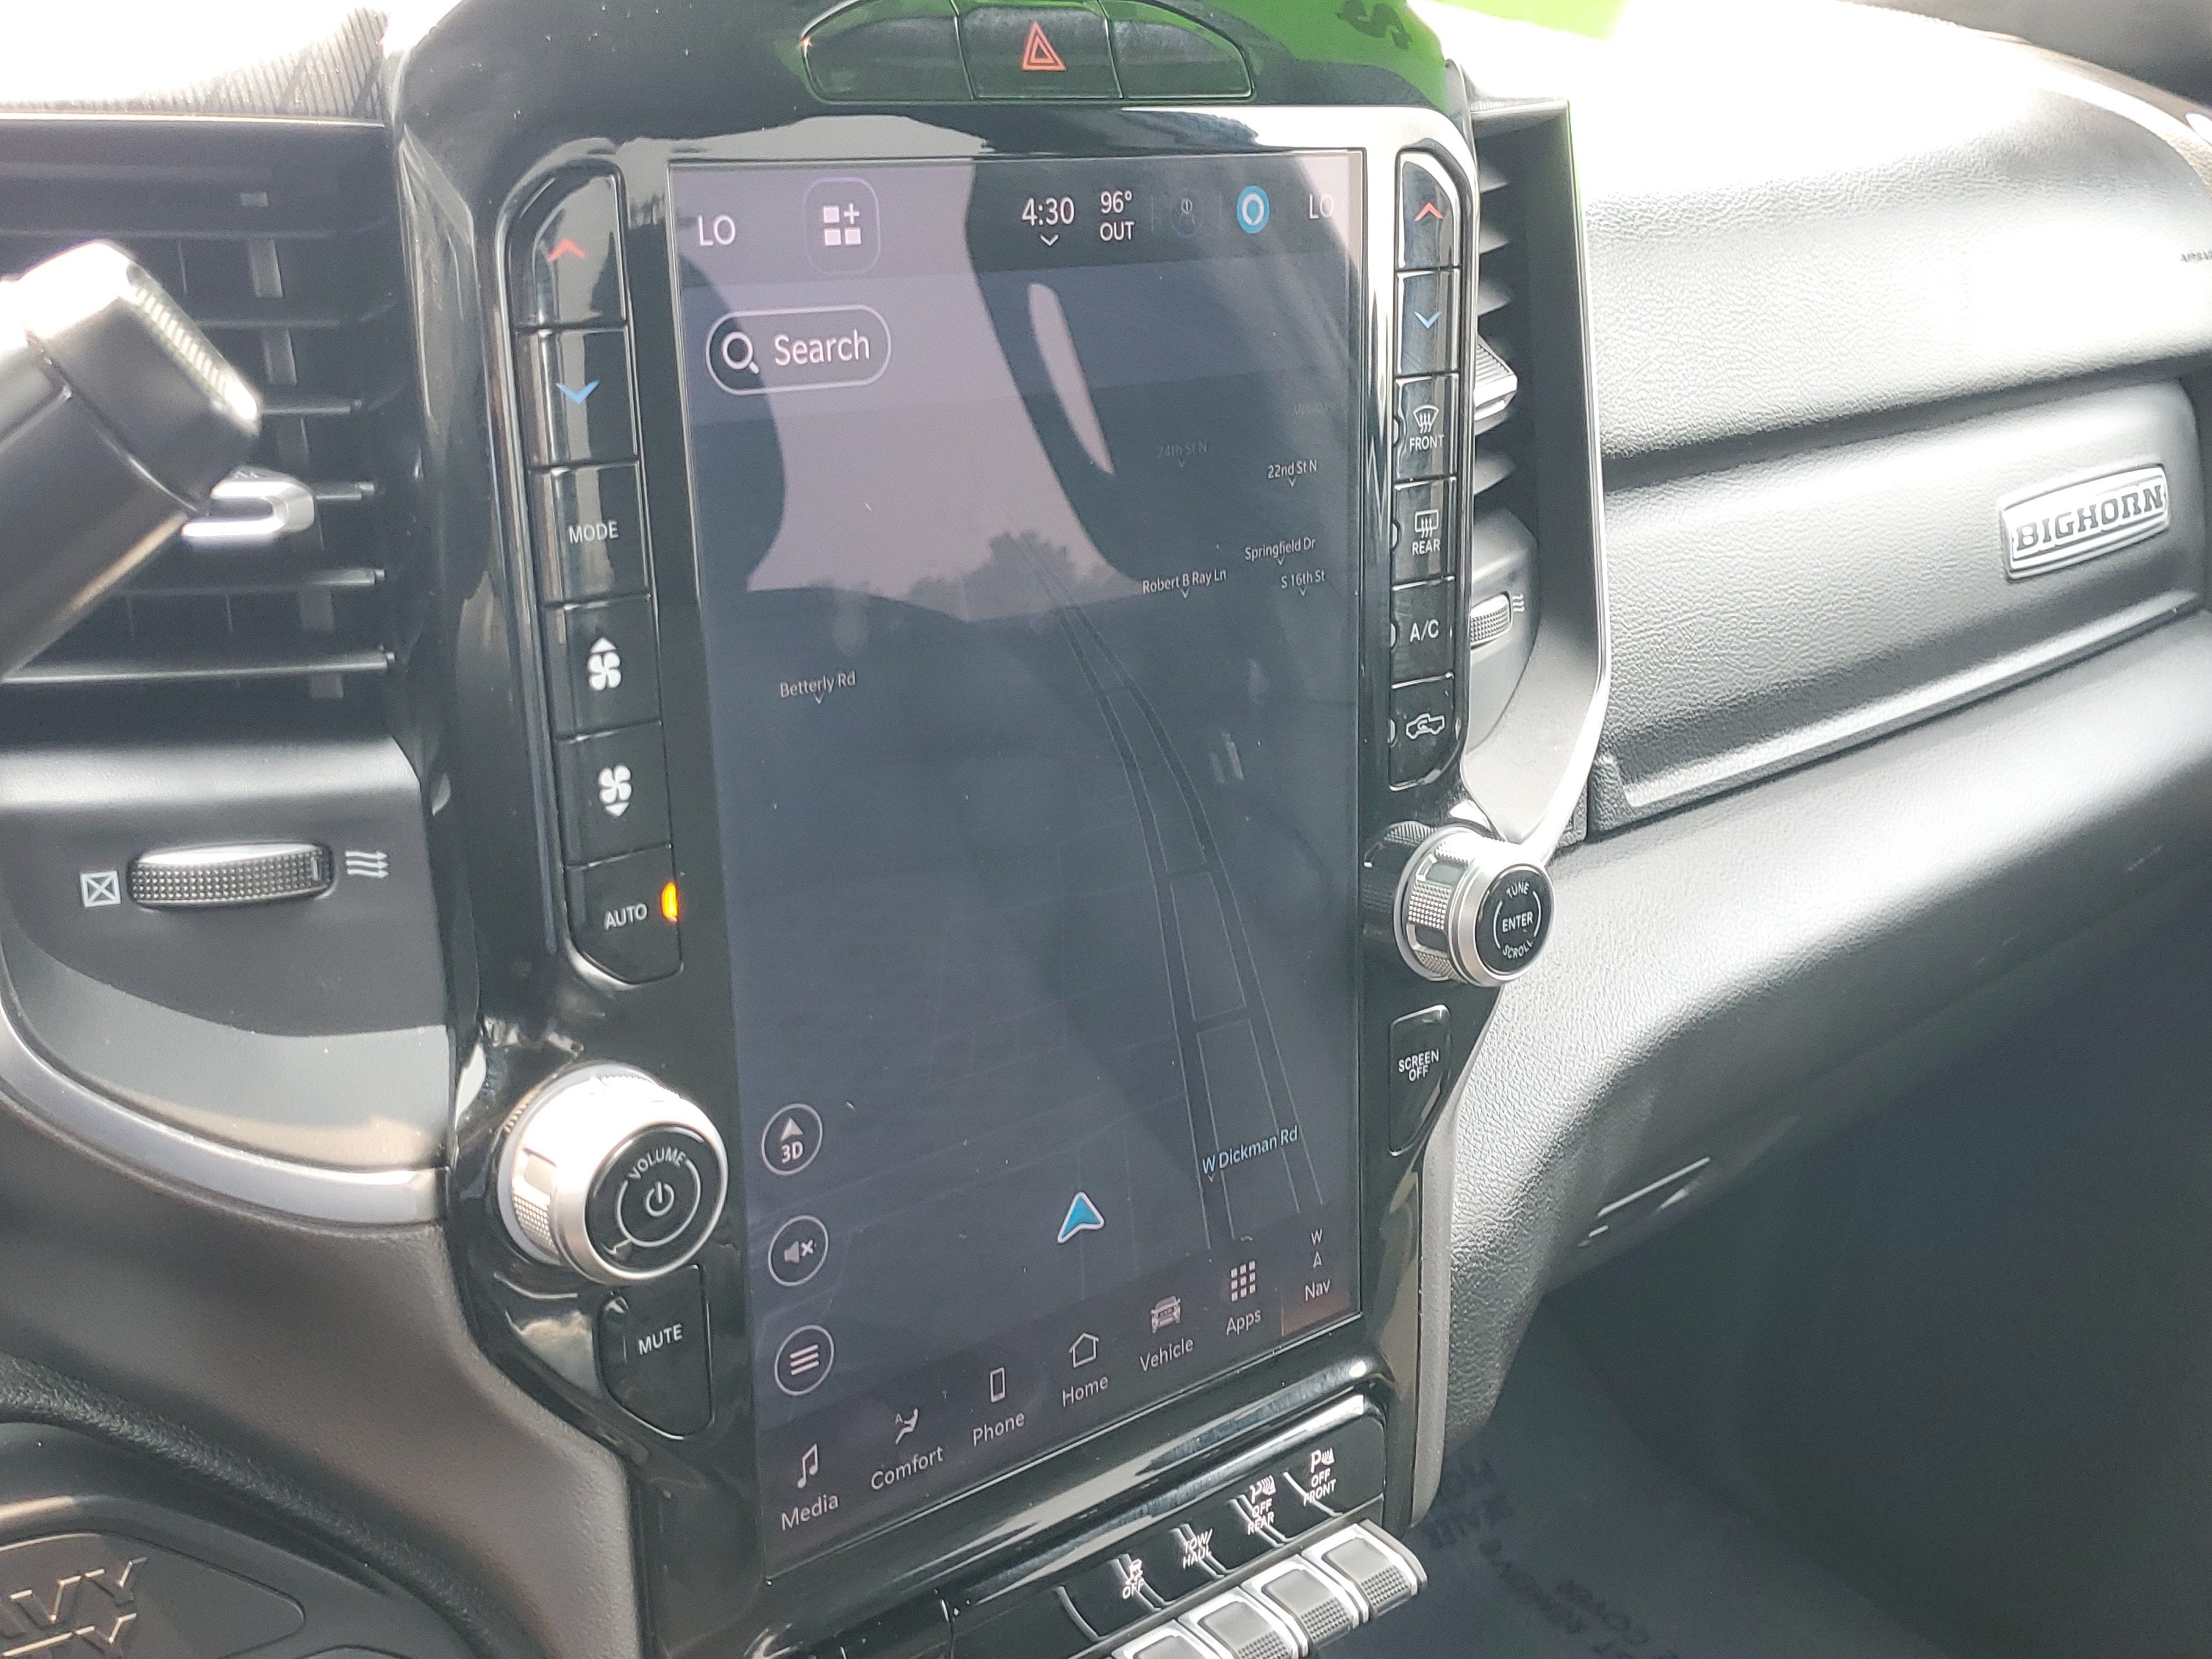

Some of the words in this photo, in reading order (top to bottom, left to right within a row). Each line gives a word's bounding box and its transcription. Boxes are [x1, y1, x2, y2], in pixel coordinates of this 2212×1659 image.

[1022, 197, 1075, 226] 4:30
[1100, 190, 1133, 213] 96°
[1308, 194, 1335, 219] LO
[698, 215, 736, 247] LO
[1100, 221, 1135, 241] OUT
[774, 329, 870, 366] Search
[1198, 440, 1207, 454] N
[1409, 433, 1444, 452] FRONT
[1268, 461, 1295, 478] 22nd
[1297, 461, 1307, 475] St
[1310, 459, 1318, 472] N
[2016, 484, 2163, 551] BIGHORN
[568, 520, 619, 544] MODE
[1245, 539, 1301, 561] Springfield
[1304, 537, 1316, 550] Dr
[1412, 539, 1441, 556] REAR
[1143, 575, 1180, 594] Robert
[1183, 573, 1190, 588] B
[1192, 571, 1212, 586] Ray
[1214, 569, 1227, 583] Ln
[1280, 575, 1288, 589] S
[1290, 572, 1313, 586] 16th
[1315, 569, 1326, 583] St
[1409, 618, 1440, 642] A/C
[779, 675, 834, 699] Betterly
[837, 670, 857, 689] Rd
[1505, 881, 1530, 898] TUNE
[603, 902, 648, 930] AUTO
[1502, 910, 1533, 933] ENTER
[1502, 939, 1534, 960] SCROLL
[1398, 1048, 1440, 1073] SCREEN
[1408, 1063, 1429, 1082] OFF
[780, 1141, 804, 1164] 3D
[1201, 1155, 1217, 1175] W
[1218, 1137, 1278, 1169] Dickman
[1280, 1125, 1298, 1147] Rd
[628, 1146, 687, 1181] VOLUME
[1311, 1228, 1323, 1245] W
[1305, 1279, 1331, 1302] Nav
[1226, 1308, 1261, 1335] Apps
[637, 1322, 684, 1356] MUTE
[1139, 1337, 1194, 1372] Vehicle
[1062, 1376, 1109, 1407] Home
[973, 1412, 1025, 1447] Phone
[871, 1446, 944, 1491] Comfort
[1311, 1467, 1331, 1488] OFF
[1303, 1479, 1336, 1508] FRONT
[780, 1492, 839, 1531] Media
[1251, 1499, 1273, 1517] OFF
[1247, 1512, 1274, 1536] REAR
[1182, 1546, 1212, 1568] HAUL
[1122, 1577, 1145, 1599] OFF
